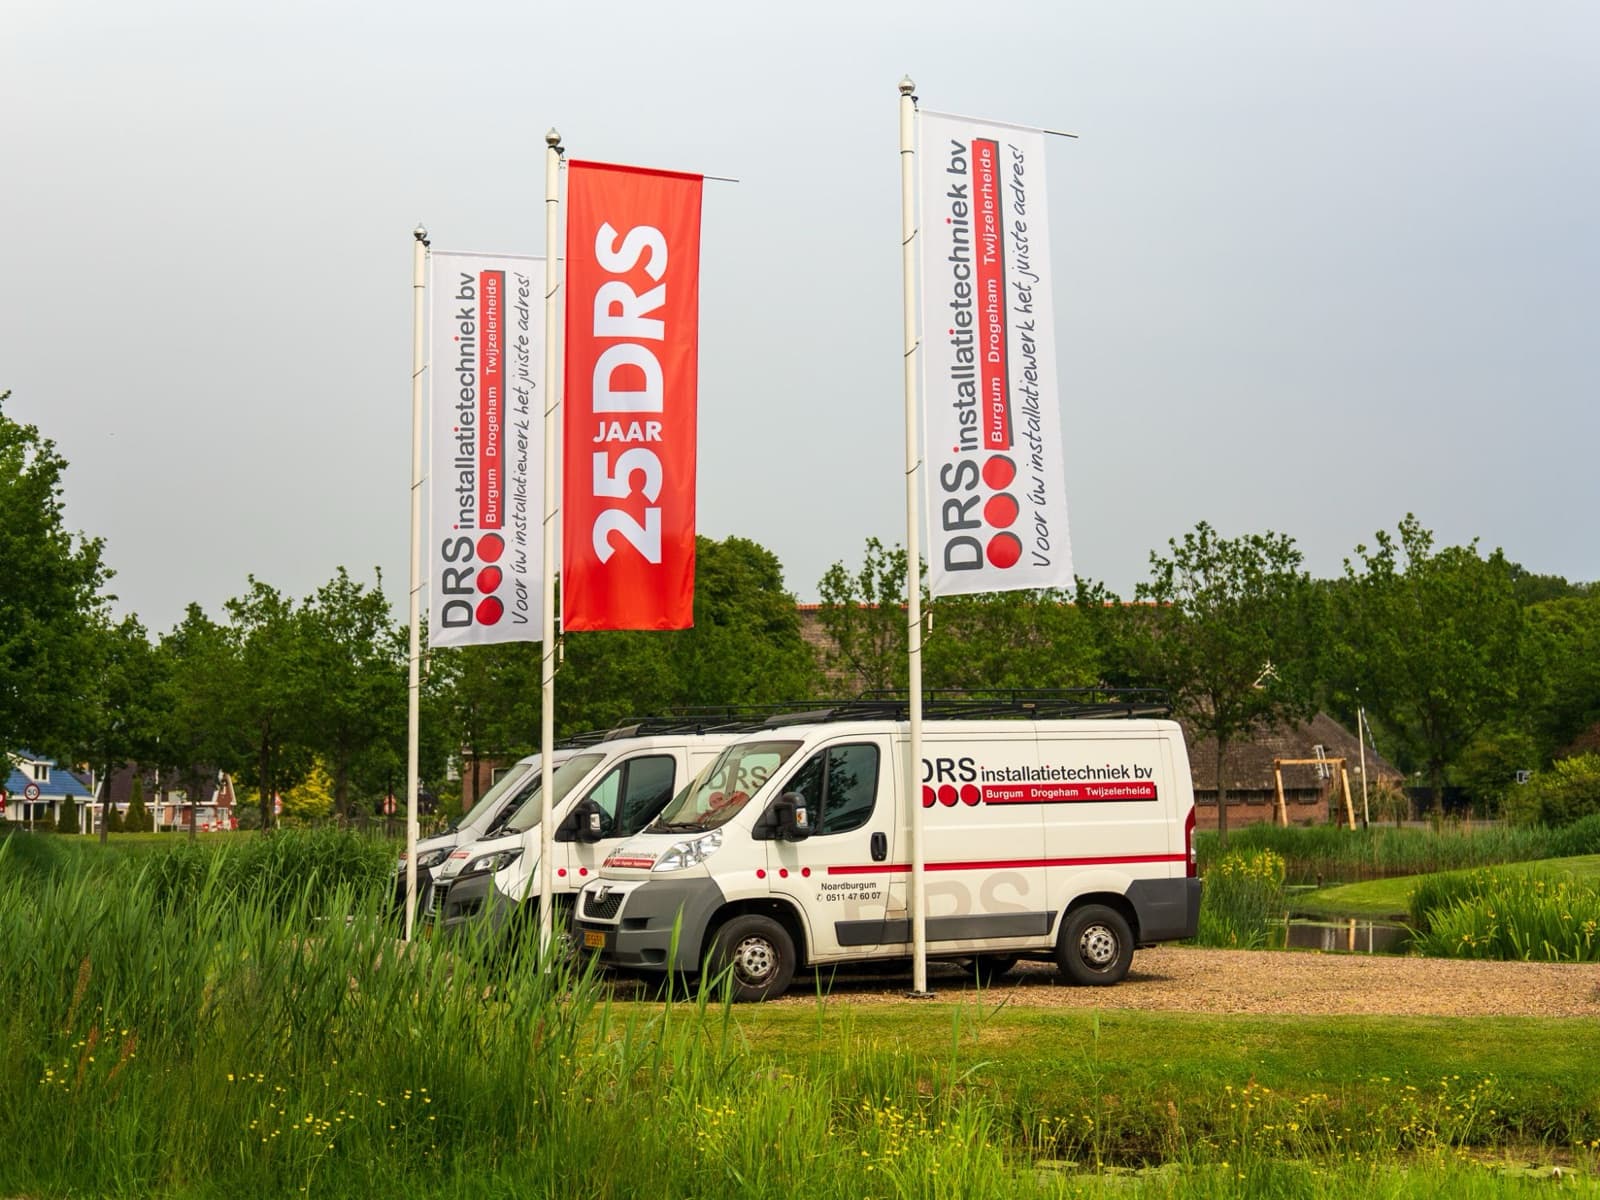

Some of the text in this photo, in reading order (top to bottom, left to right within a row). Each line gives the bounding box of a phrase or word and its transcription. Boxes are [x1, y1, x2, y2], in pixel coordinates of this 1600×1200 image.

[1007, 143, 1025, 216] adres!
[1010, 220, 1040, 283] juiste
[513, 272, 530, 331] adres!
[980, 148, 1003, 442] Burgum Drogeham Twijzelerheide
[1012, 281, 1033, 314] het
[512, 335, 536, 389] juiste
[940, 139, 984, 572] DRS installatietechniek bv
[486, 278, 499, 523] Burgum Drogeham Twijzelerheide
[512, 386, 529, 415] het
[593, 222, 668, 565] 25 JAAR DRS
[1014, 319, 1044, 473] installatiewerk
[442, 272, 475, 628] DRS installatietechniek bv
[512, 420, 529, 546] installatiewerk
[1031, 511, 1051, 567] Voor
[512, 578, 528, 624] Voor
[980, 764, 1130, 782] installatietechniek
[1134, 764, 1153, 780] bv
[986, 785, 1151, 800] Burgum Drogeham Twijzelerheide
[821, 882, 877, 891] Noardburgum
[826, 891, 882, 902] 0511 47 60 07
